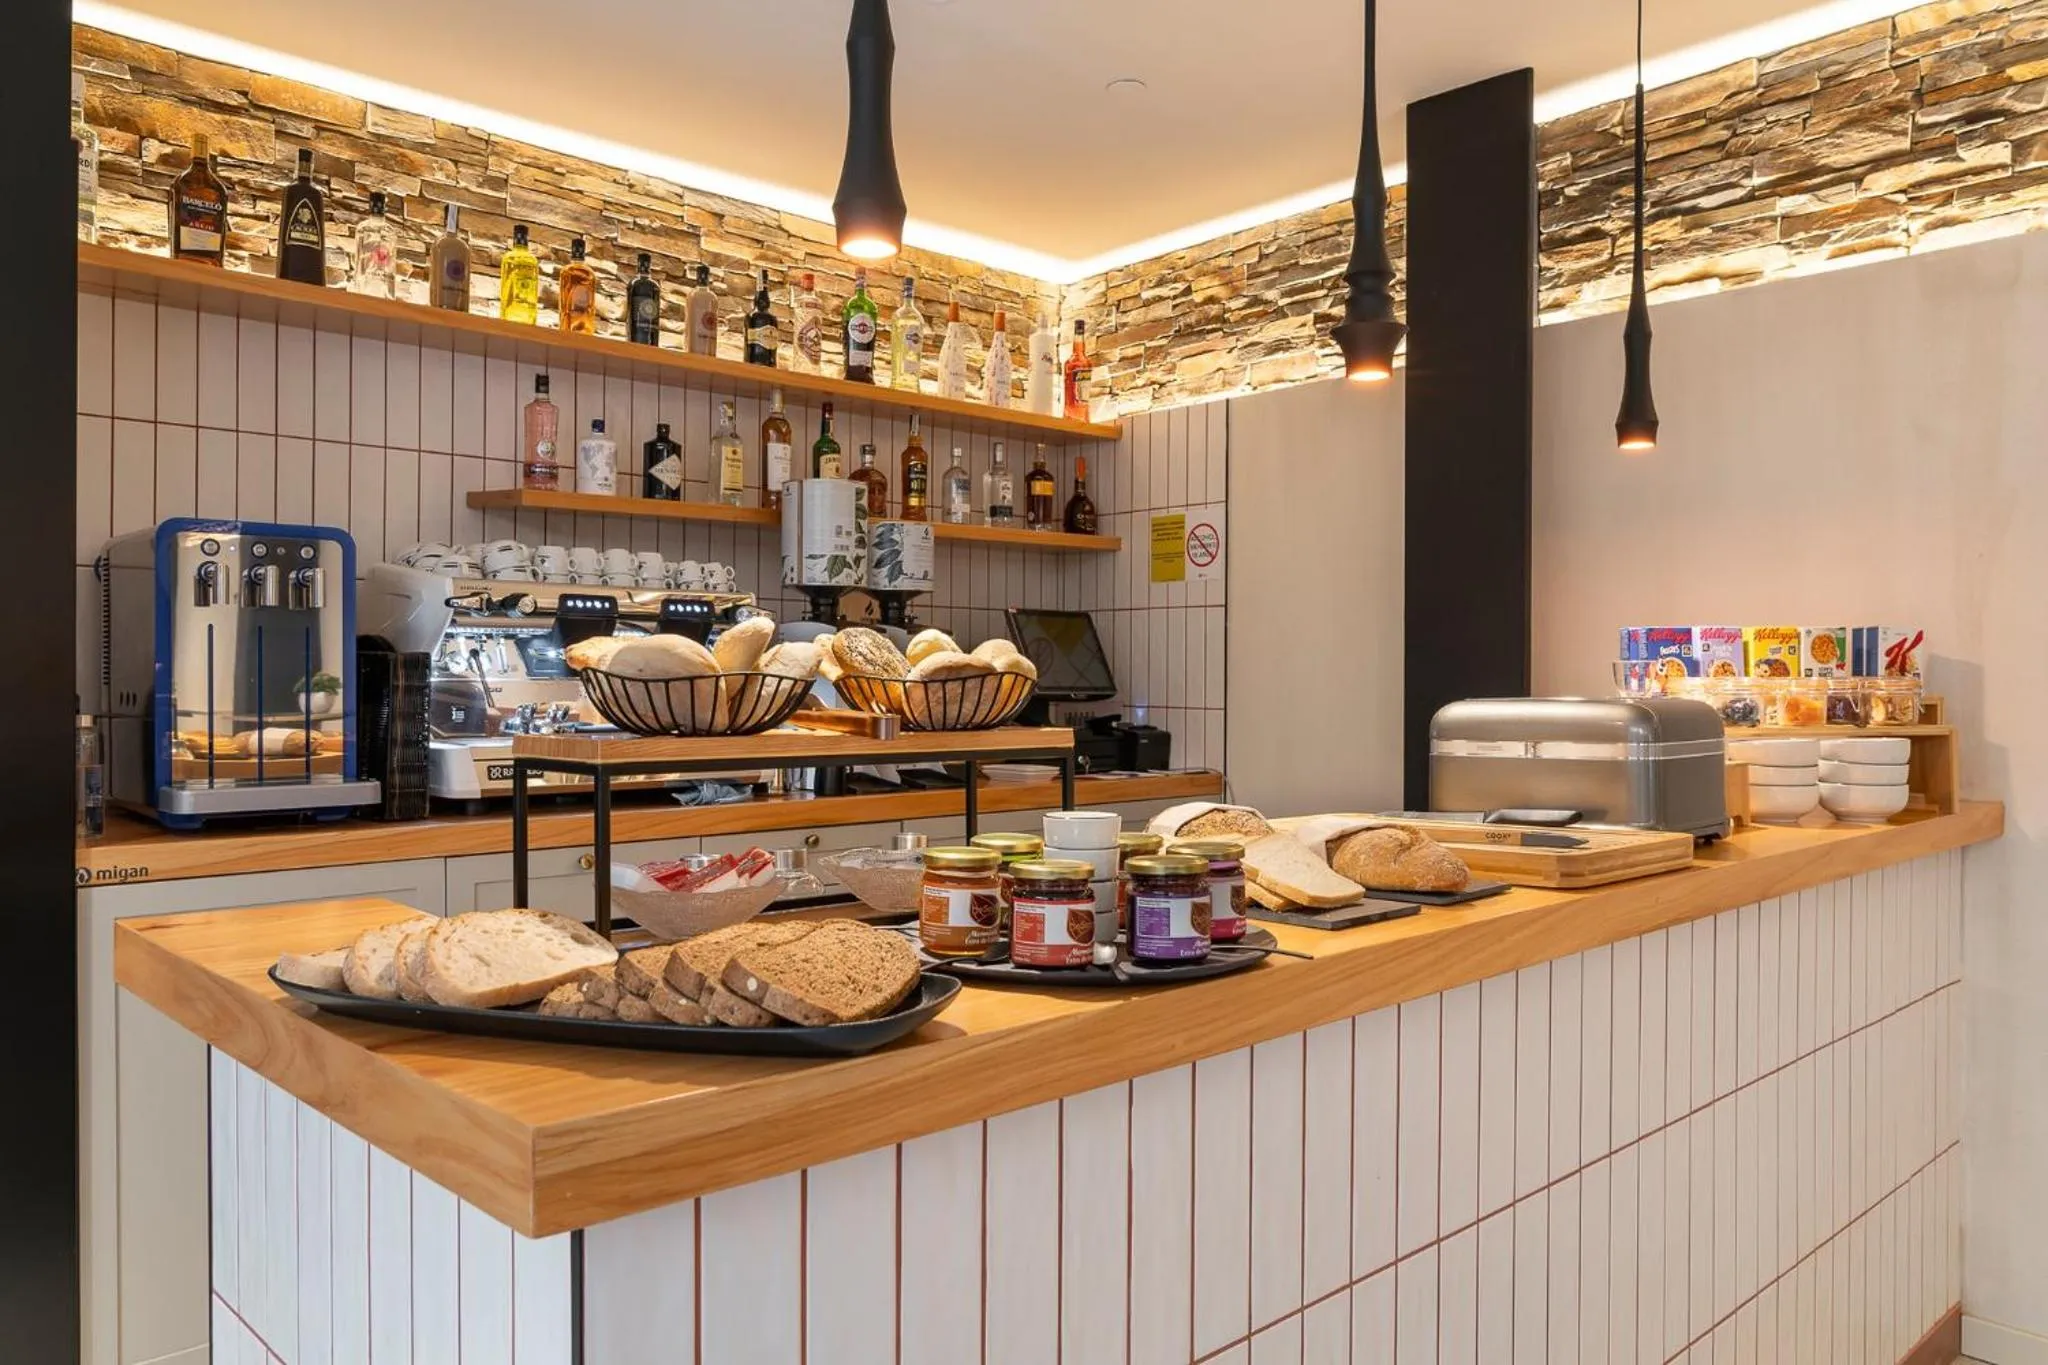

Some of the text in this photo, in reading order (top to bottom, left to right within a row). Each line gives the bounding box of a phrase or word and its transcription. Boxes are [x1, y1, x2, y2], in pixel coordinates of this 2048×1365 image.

[1699, 627, 1742, 644] Kellogg's
[1754, 627, 1799, 644] Kellogg's
[96, 865, 149, 882] migan
